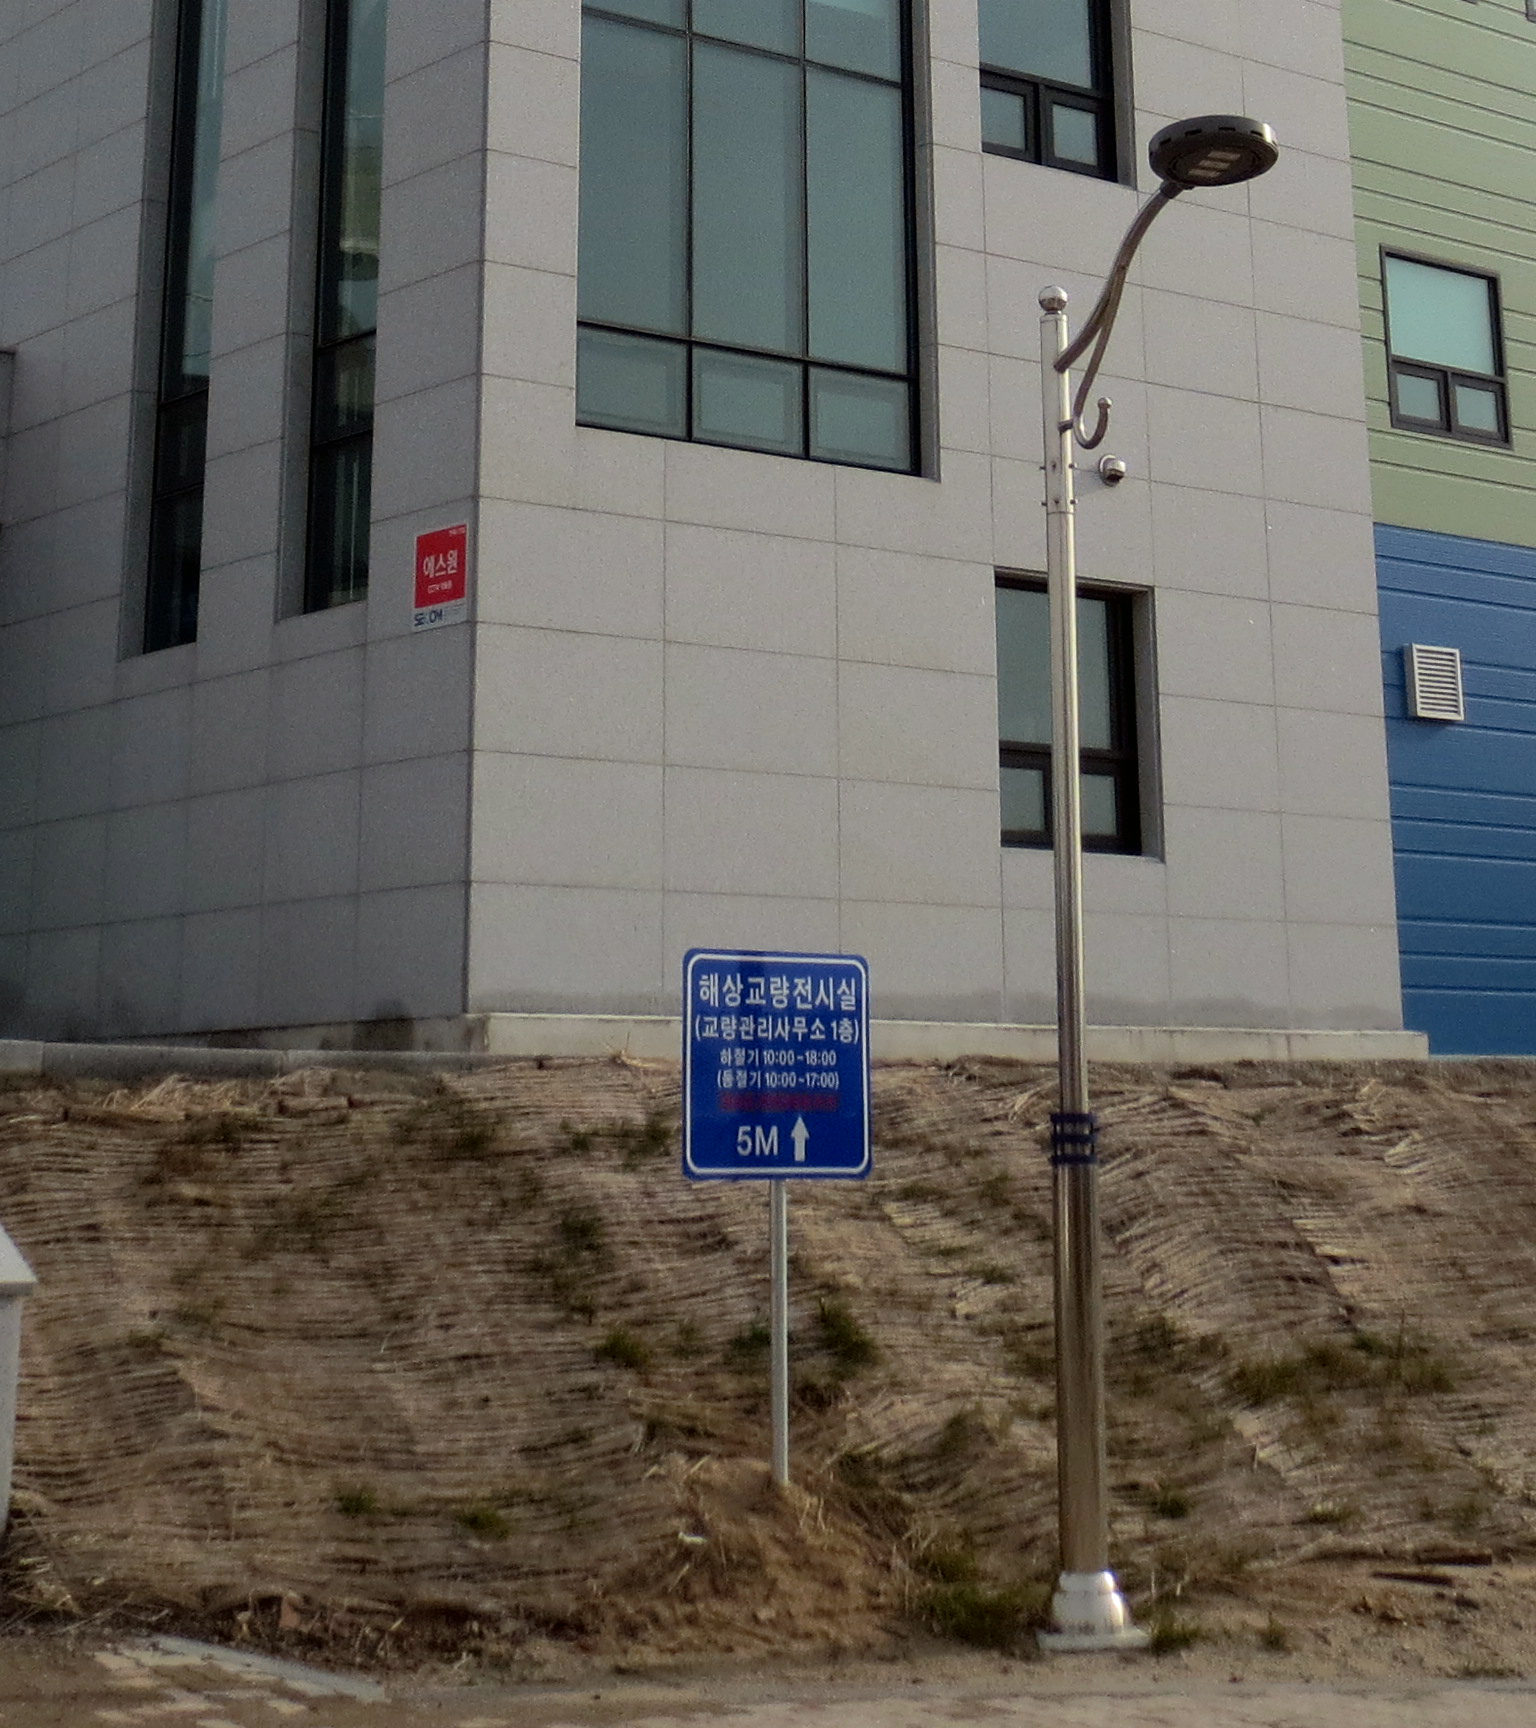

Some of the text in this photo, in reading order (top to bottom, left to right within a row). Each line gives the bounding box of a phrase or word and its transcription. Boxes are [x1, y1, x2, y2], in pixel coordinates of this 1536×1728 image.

[423, 549, 458, 579] 에스원
[699, 973, 856, 1011] 해상교량전시실
[695, 1015, 859, 1044] (교량관리사무소 1층)
[720, 1048, 759, 1066] 하절기
[717, 1070, 762, 1089] (동절기
[736, 1125, 779, 1156] 5M
